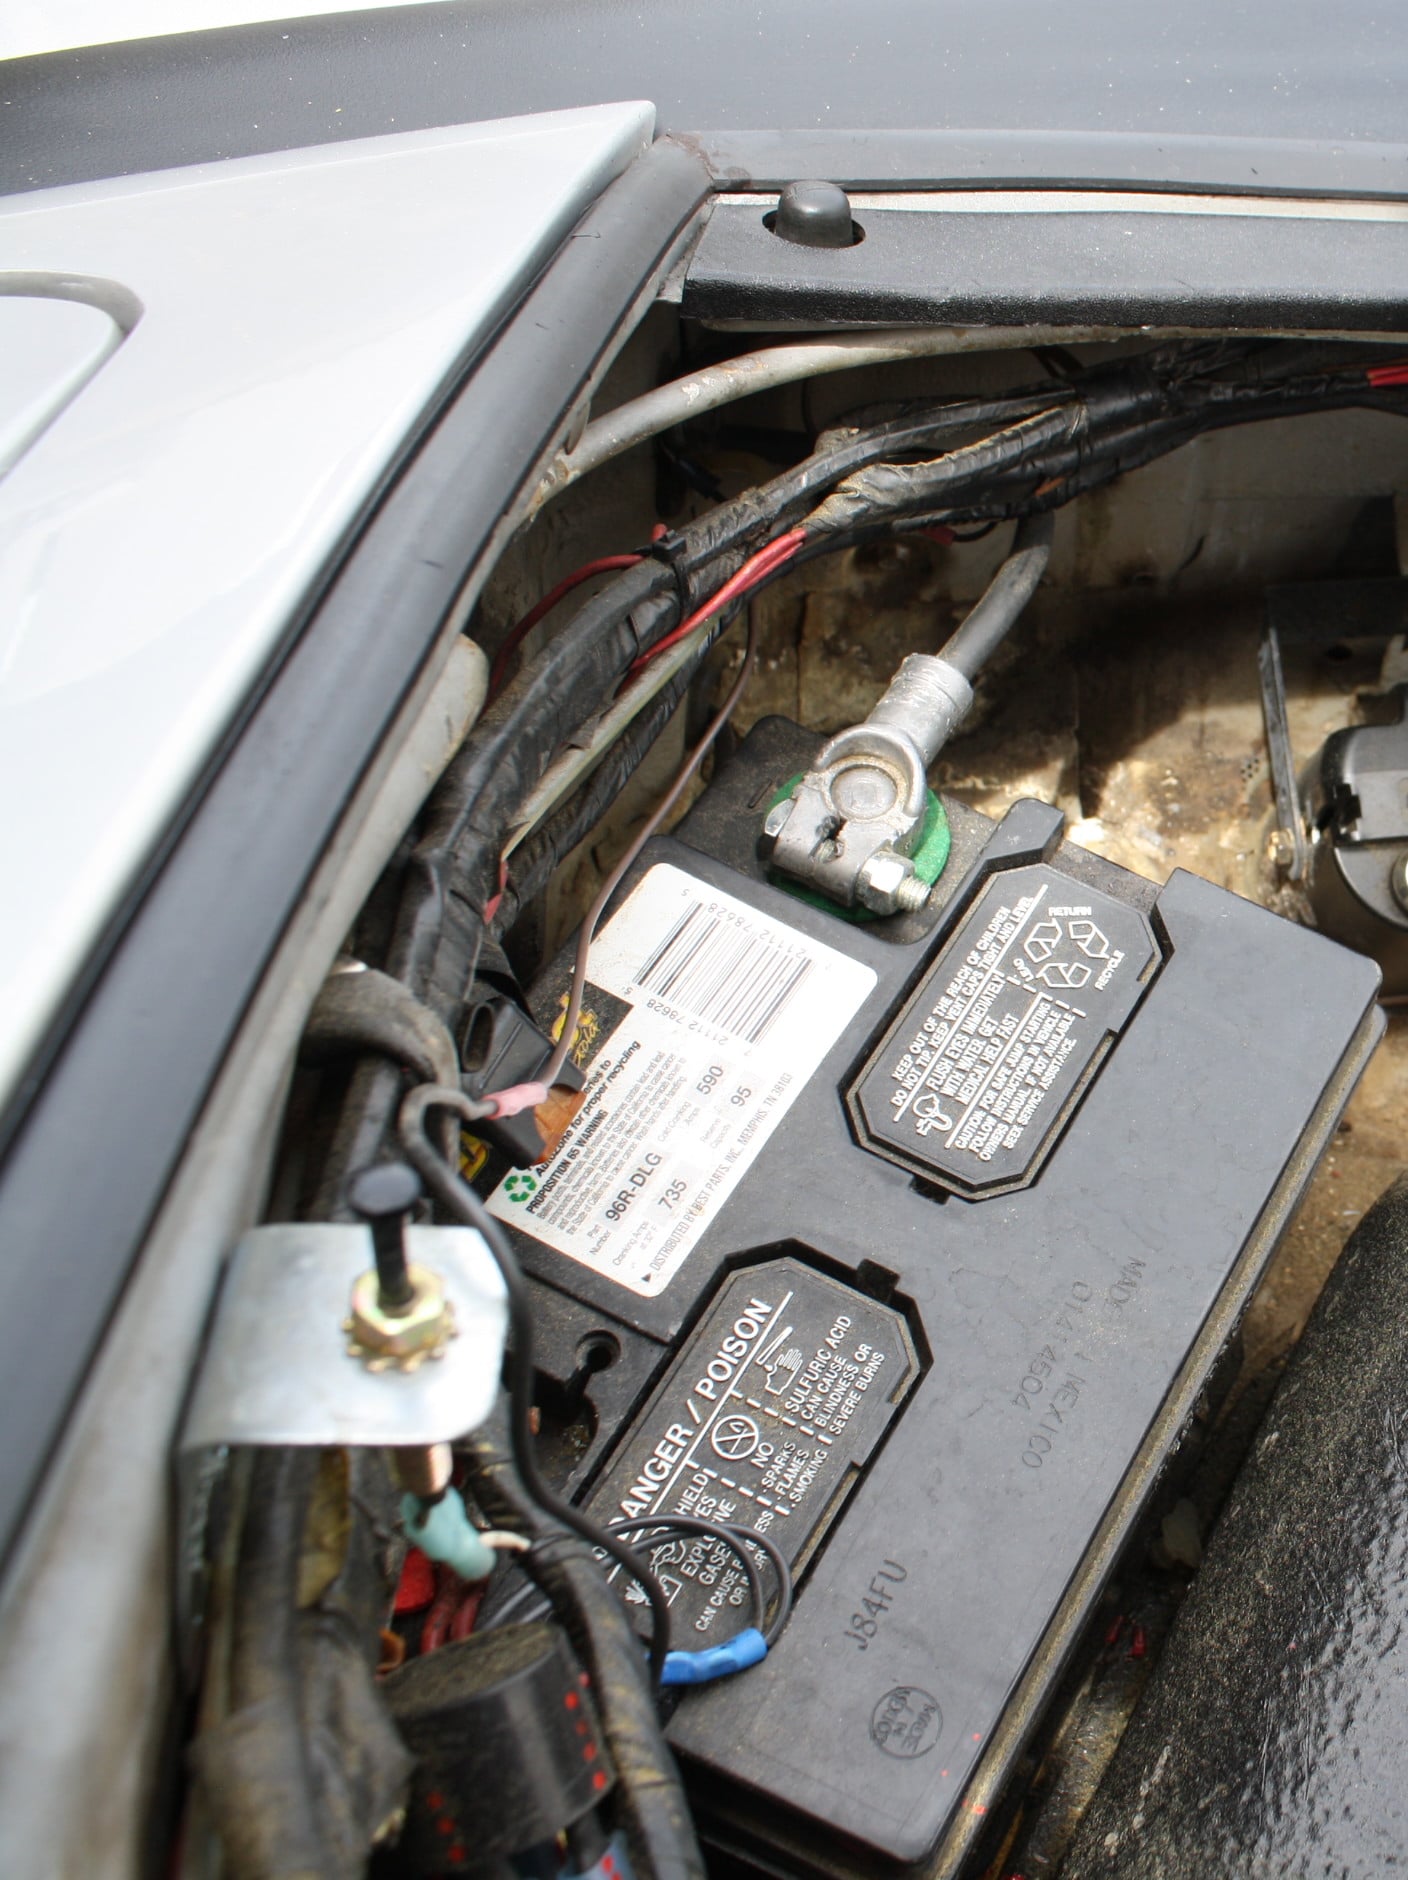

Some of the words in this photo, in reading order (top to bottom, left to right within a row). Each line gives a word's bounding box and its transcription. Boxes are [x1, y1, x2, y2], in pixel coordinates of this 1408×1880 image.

[891, 1052, 915, 1082] KEEP
[907, 1030, 929, 1056] OUT
[921, 1015, 939, 1034] OF
[931, 994, 953, 1018] THE
[945, 963, 973, 998] REACH
[965, 949, 982, 966] OF
[974, 904, 1011, 952] CHILDREN
[1092, 948, 1126, 992] RECYCLE
[647, 997, 685, 1024] 78628
[890, 1087, 909, 1107] DO
[900, 1066, 922, 1091] NOT
[915, 1045, 935, 1069] TIP.
[927, 1019, 952, 1049] KEEP
[943, 994, 968, 1023] VENT
[960, 968, 985, 997] CAPS
[977, 941, 1002, 971] TIGHT
[995, 920, 1015, 943] AND
[924, 1055, 955, 1091] FLUSH
[944, 1031, 970, 1061] EYES
[959, 973, 1007, 1036] IMMEDIATELY
[1033, 1008, 1062, 1046] VEHICLE
[598, 1057, 612, 1072] to
[695, 1063, 724, 1096] 590
[939, 1069, 965, 1099] WITH
[977, 1014, 999, 1039] GET
[954, 1060, 990, 1105] MEDICAL
[980, 1035, 1005, 1065] HELP
[995, 1012, 1020, 1040] FAST
[978, 1087, 998, 1111] FOR
[990, 1065, 1013, 1091] SAFE
[1004, 1041, 1027, 1068] JUMP
[1019, 1000, 1052, 1044] STARTING
[1026, 1042, 1041, 1057] IN
[569, 1112, 585, 1130] for
[581, 1081, 609, 1116] proper
[604, 1039, 641, 1085] recycling
[729, 1083, 753, 1109] 95
[977, 1120, 1010, 1163] OWNERS
[1023, 1073, 1038, 1087] IF
[1031, 1055, 1050, 1076] NOT
[1041, 1011, 1077, 1057] AVAILABLE
[988, 1052, 1036, 1117] INSTRUCTIONS
[967, 1114, 998, 1153] FOLLOW
[1001, 1122, 1024, 1150] SEEK
[1015, 1087, 1046, 1126] SERVICE
[525, 1156, 571, 1215] PROPOSITION
[566, 1146, 580, 1160] 65
[575, 1106, 609, 1148] WARNING
[604, 1149, 662, 1224] 96R-DLG
[649, 1219, 690, 1271] DISTRIBUTED
[683, 1208, 697, 1222] BY
[691, 1189, 711, 1211] BEST
[762, 1093, 777, 1108] TN
[657, 1176, 688, 1212] 735
[693, 1294, 773, 1402] POISON
[783, 1347, 833, 1415] SULFURIC
[822, 1313, 853, 1349] ACID
[800, 1394, 823, 1421] CAN
[815, 1353, 847, 1394] CAUSE
[813, 1362, 861, 1428] BLINDNESS
[853, 1341, 873, 1363] OR
[827, 1390, 862, 1436] SEVERE
[853, 1350, 886, 1392] BURNS
[750, 1439, 776, 1469] NO
[760, 1439, 797, 1489] SPARKS
[774, 1448, 810, 1496] FLAMES
[788, 1447, 829, 1503] SMOKING
[673, 1470, 710, 1517] HIELD
[678, 1497, 737, 1578] EXPLIVE
[693, 1604, 717, 1632] CAN
[708, 1568, 740, 1608] CAUSE
[728, 1585, 748, 1607] OR
[842, 1558, 907, 1652] J84FU
